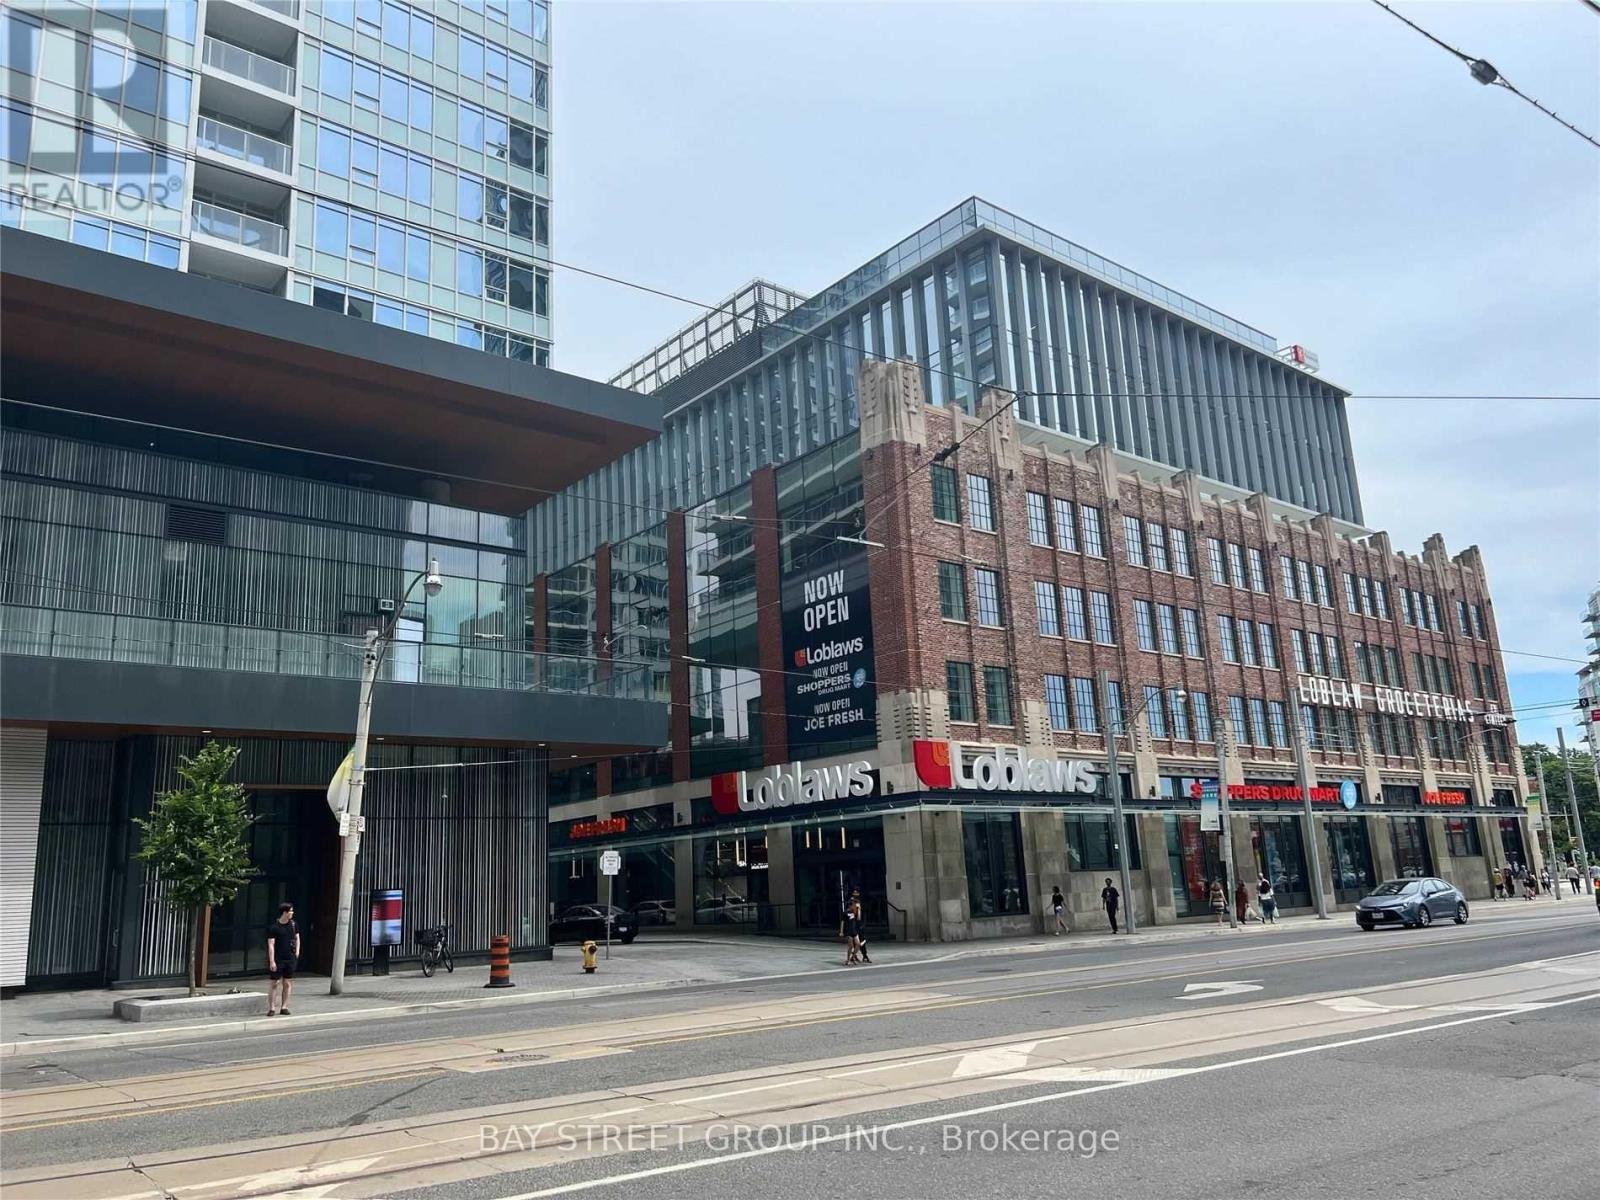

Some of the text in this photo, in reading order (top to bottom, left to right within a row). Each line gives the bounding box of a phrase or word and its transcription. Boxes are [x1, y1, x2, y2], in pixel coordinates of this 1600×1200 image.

[804, 570, 844, 604] NOW
[804, 596, 849, 632] OPEN
[806, 637, 864, 665] Loblaws
[813, 661, 849, 678] NOW OPEN
[797, 673, 851, 694] SHOPPERS
[818, 683, 851, 696] DRUG MART
[814, 697, 850, 715] NOW OPEN
[1298, 676, 1475, 723] LOBLAW GROCETERIAS
[804, 708, 864, 732] JOE FRESH
[952, 741, 1099, 793] Loblaws
[737, 760, 874, 812] Loblaws
[1190, 783, 1270, 800] SPPERS
[1309, 787, 1340, 801] MART
[1441, 792, 1466, 805] FRESH
